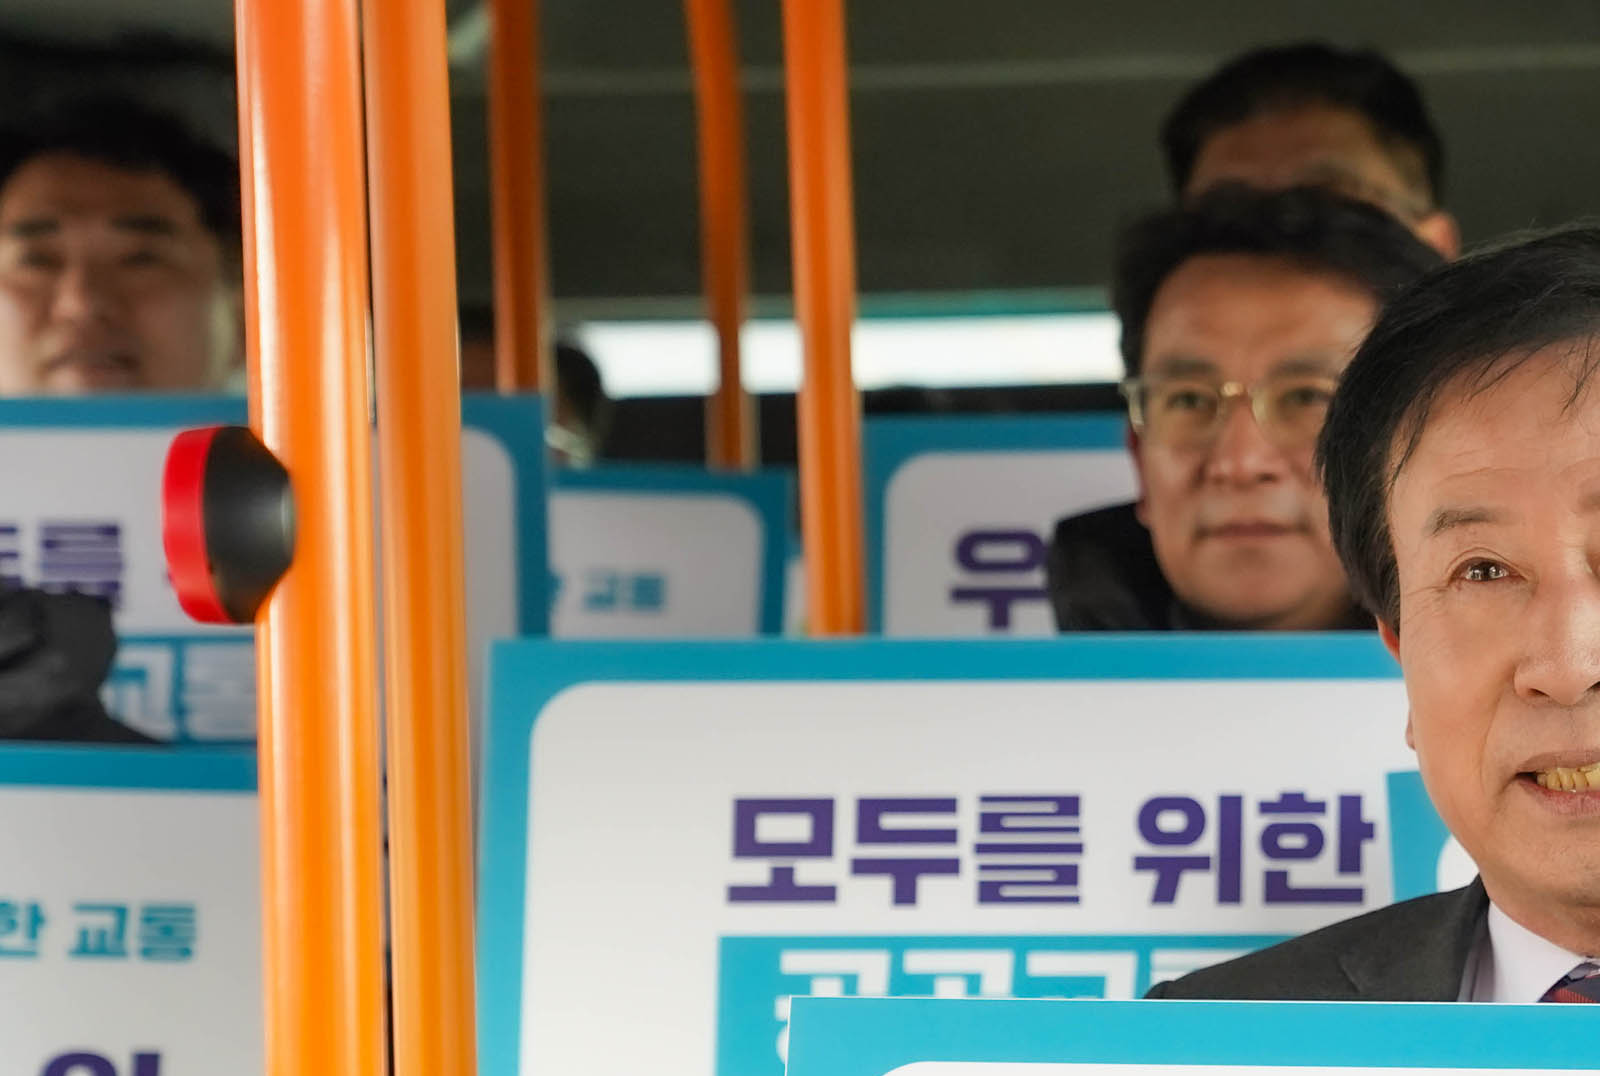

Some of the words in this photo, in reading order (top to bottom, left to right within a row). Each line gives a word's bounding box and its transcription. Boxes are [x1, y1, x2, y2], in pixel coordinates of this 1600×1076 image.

[727, 793, 1084, 906] 모두를
[1133, 791, 1377, 906] 위한
[68, 901, 197, 963] 교통
